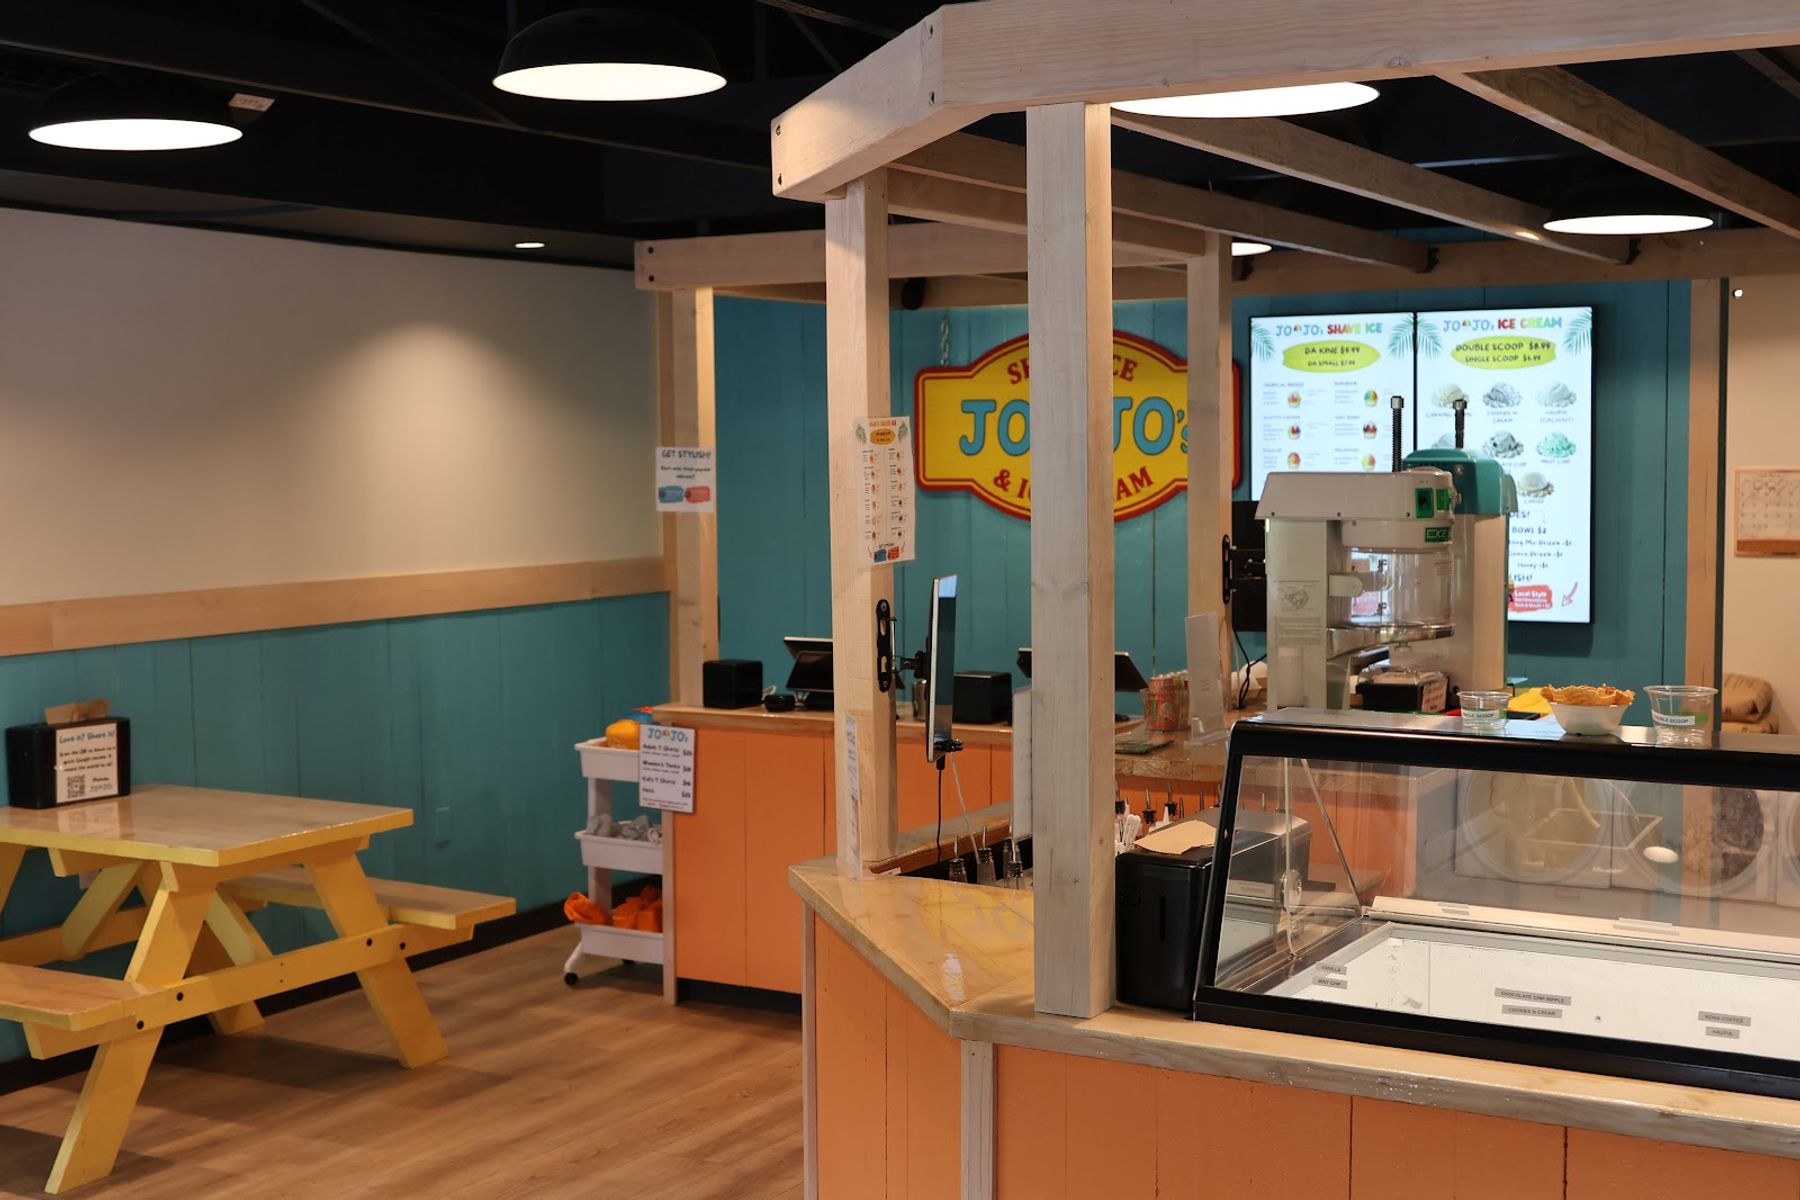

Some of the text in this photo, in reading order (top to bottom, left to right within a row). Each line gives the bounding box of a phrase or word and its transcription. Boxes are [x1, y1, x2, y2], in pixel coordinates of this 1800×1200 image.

[1498, 318, 1515, 329] ICE
[1520, 317, 1562, 328] CREAM
[1327, 323, 1361, 334] SHAVE
[1365, 322, 1383, 333] ICE
[1456, 343, 1489, 351] DOUBLE
[1492, 342, 1524, 351] SCOOP
[1465, 355, 1489, 363] SINGLE
[661, 449, 676, 458] GET
[993, 468, 1011, 491] &
[1500, 991, 1532, 999] CHOCOLATE
